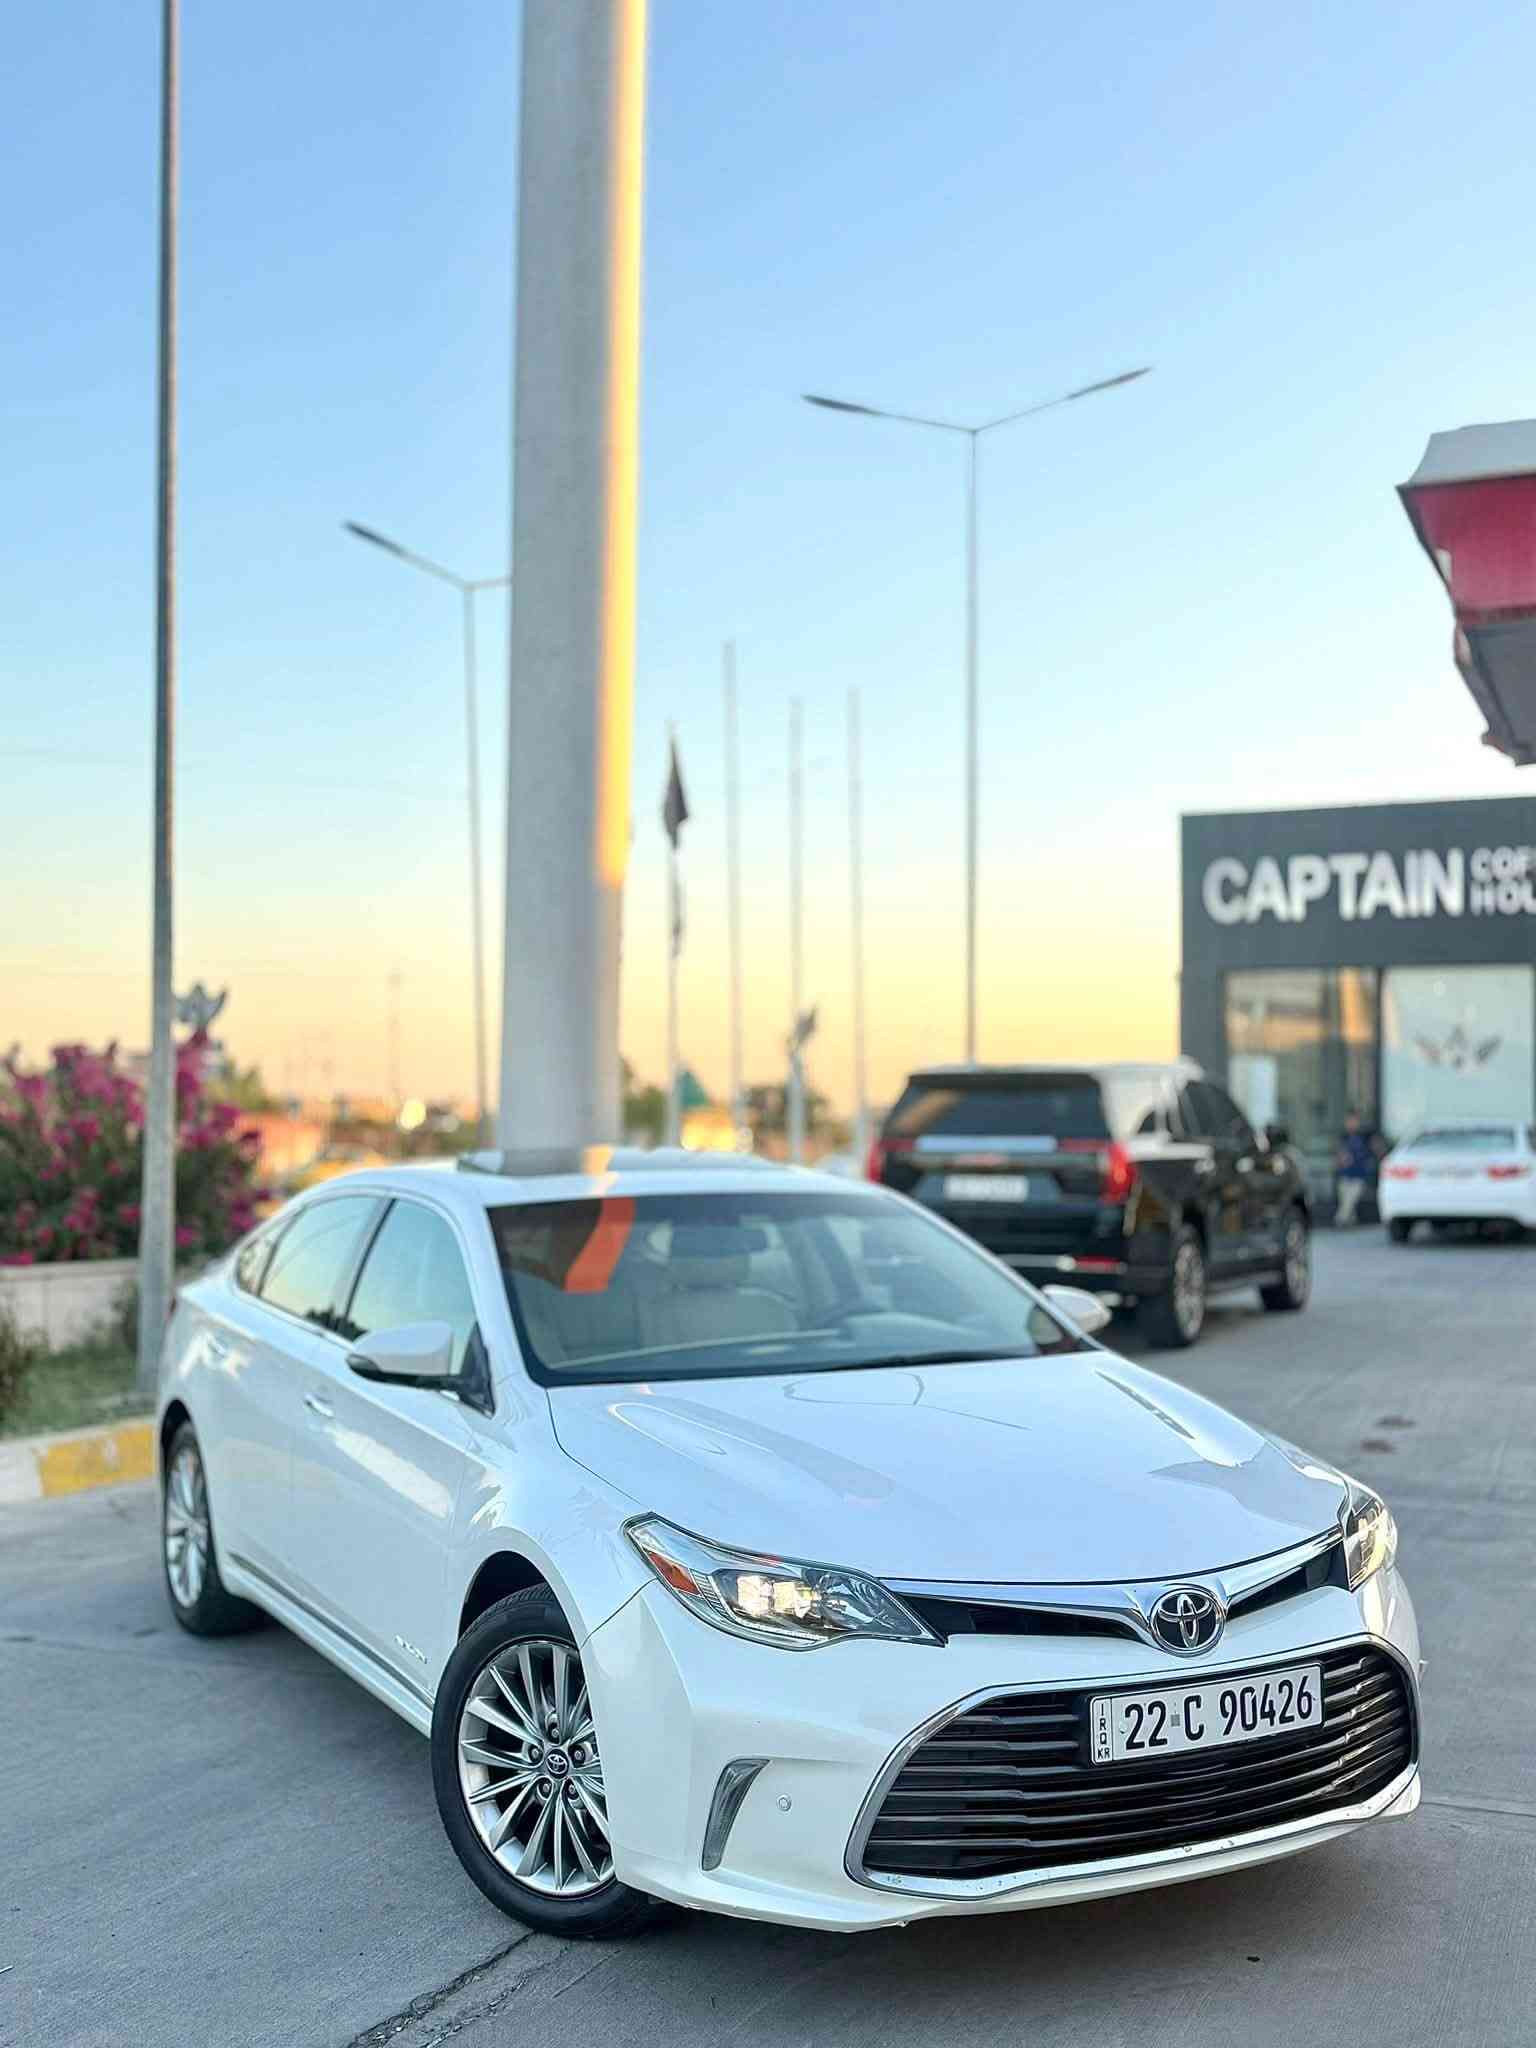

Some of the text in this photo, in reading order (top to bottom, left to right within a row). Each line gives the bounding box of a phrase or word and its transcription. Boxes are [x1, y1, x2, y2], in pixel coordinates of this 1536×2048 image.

[1203, 848, 1465, 923] CAPTAIN
[1124, 1675, 1313, 1750] 22 C 90426
